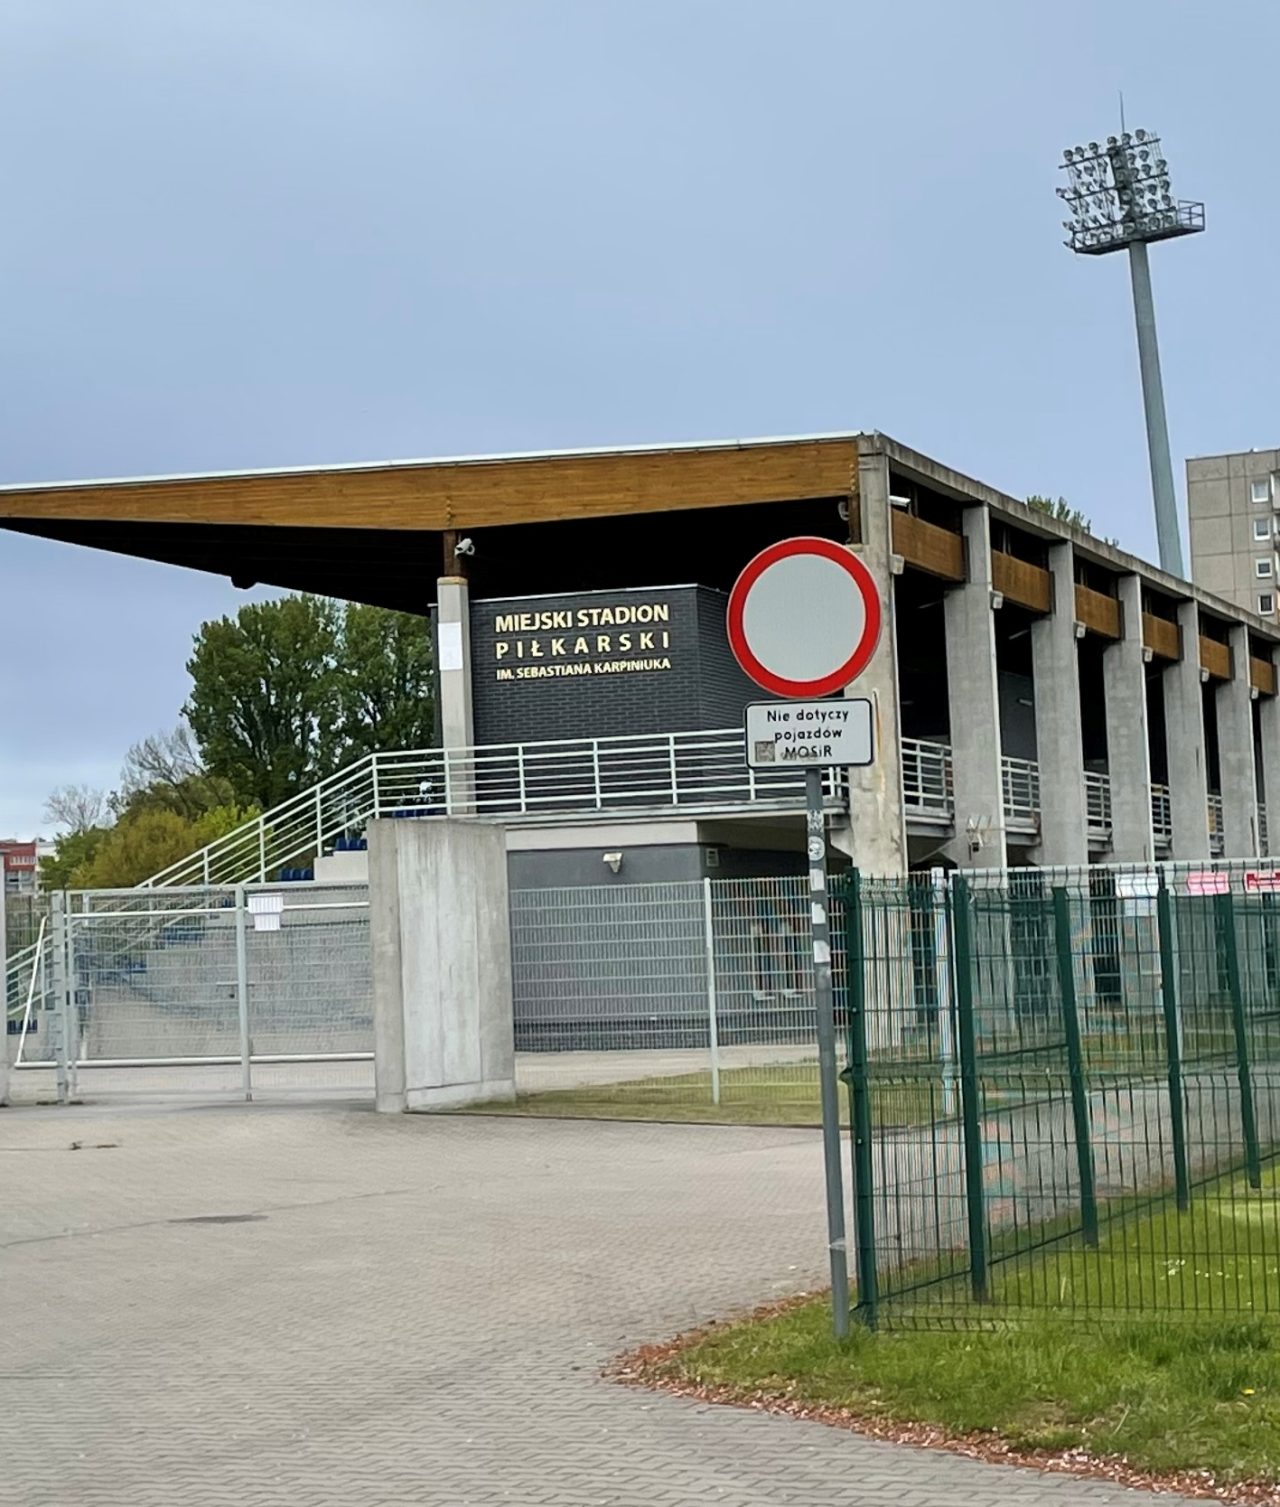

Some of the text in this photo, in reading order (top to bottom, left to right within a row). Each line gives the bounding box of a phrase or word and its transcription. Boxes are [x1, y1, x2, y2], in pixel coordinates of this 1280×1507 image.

[495, 604, 669, 633] MIEJSKI STADION
[495, 632, 669, 660] PIŁKARSKI
[496, 658, 671, 681] IM. SEBASTIANA KARPINIUKA
[767, 709, 849, 723] Nie dotyczy
[774, 727, 842, 743] pojazdów
